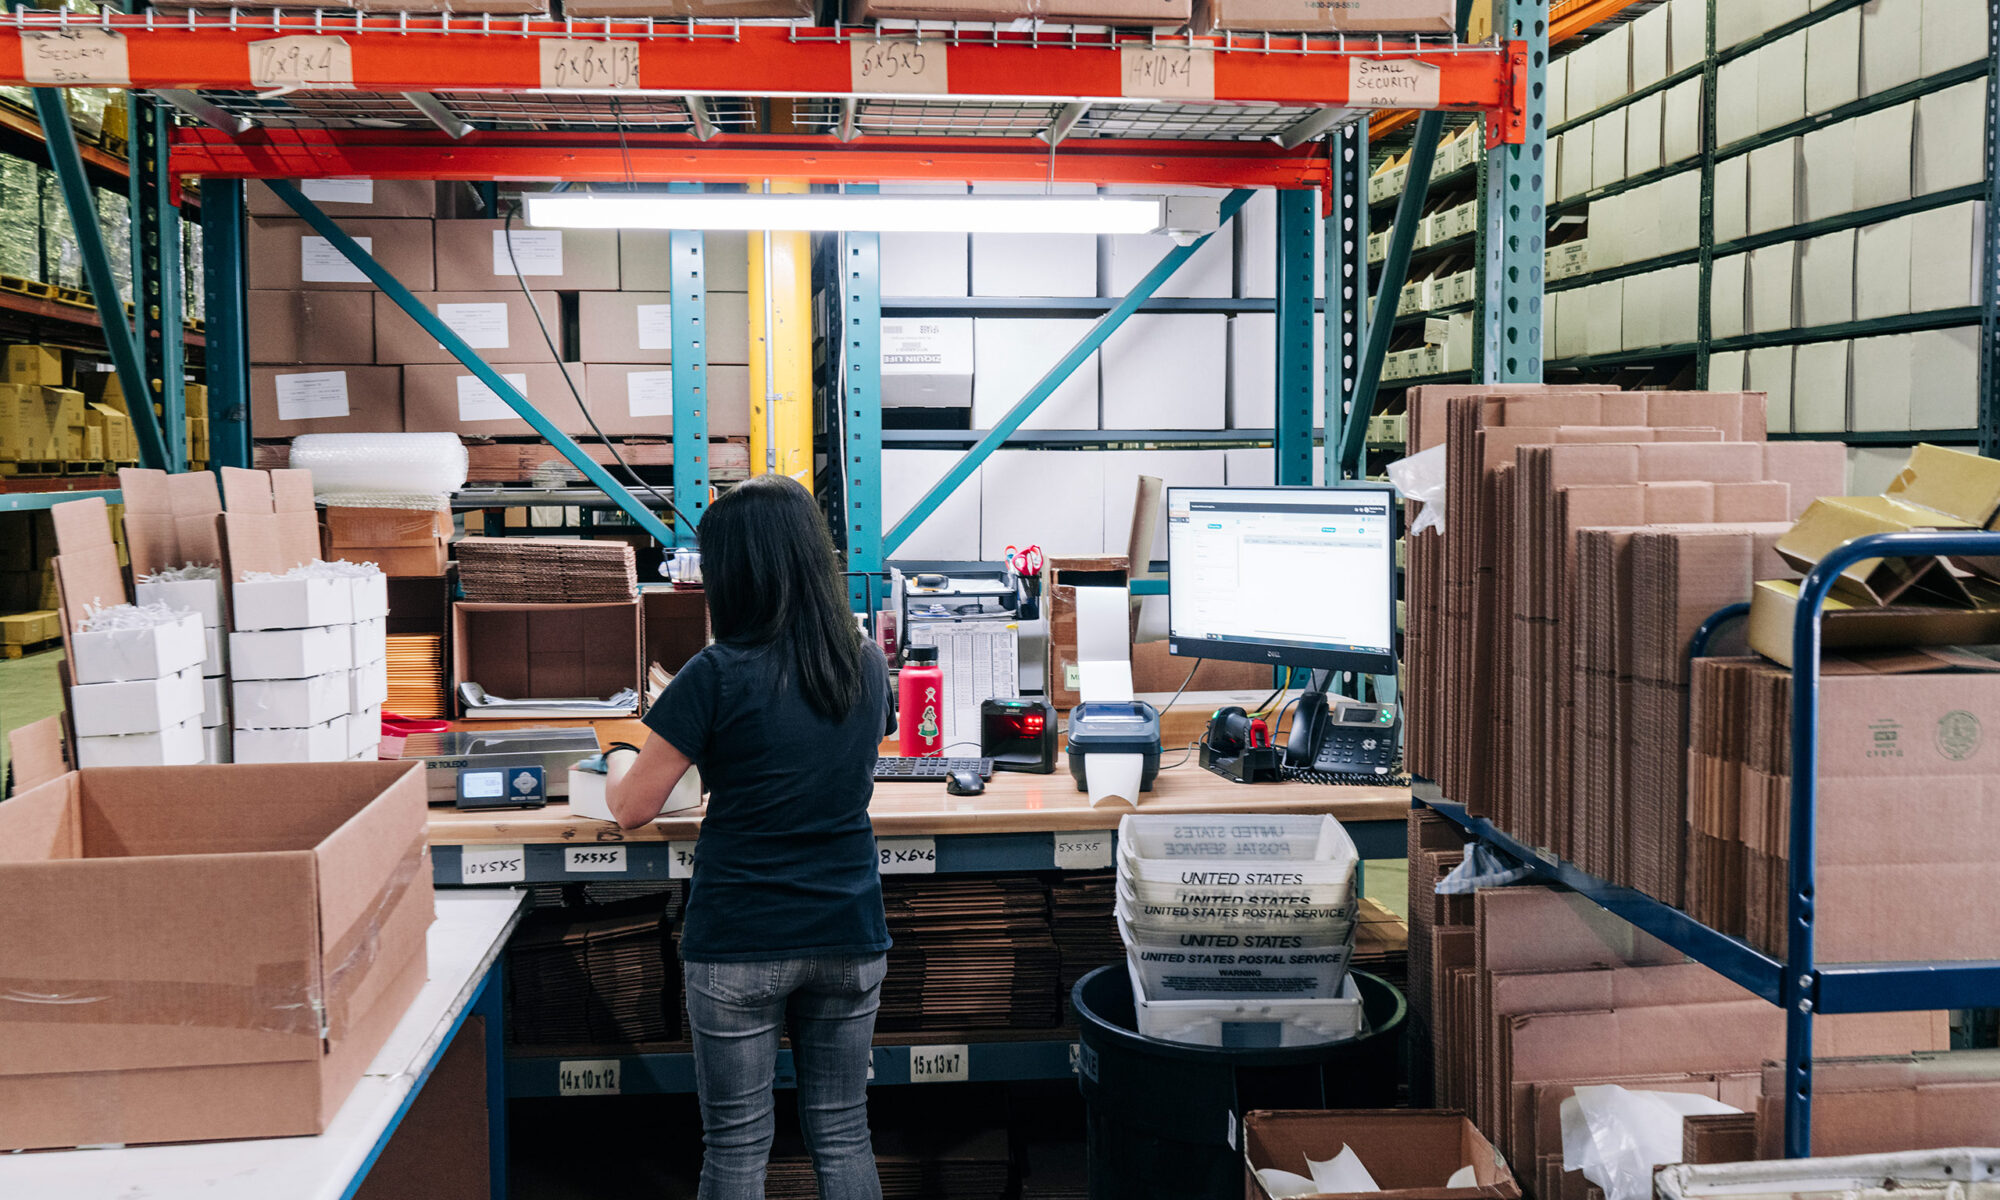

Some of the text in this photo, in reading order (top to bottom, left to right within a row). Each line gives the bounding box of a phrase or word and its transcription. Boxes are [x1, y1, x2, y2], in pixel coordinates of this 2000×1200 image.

[1360, 62, 1404, 74] SMALL
[1356, 76, 1418, 92] SECURITY
[1182, 872, 1303, 885] UNITED STATES
[1144, 906, 1345, 918] UNITED STATES POSTAL SERVICE
[1180, 935, 1302, 948] UNITED STATES
[1141, 952, 1342, 964] UNITED STATES POSTAL SERVICE
[1218, 969, 1262, 977] WARNING
